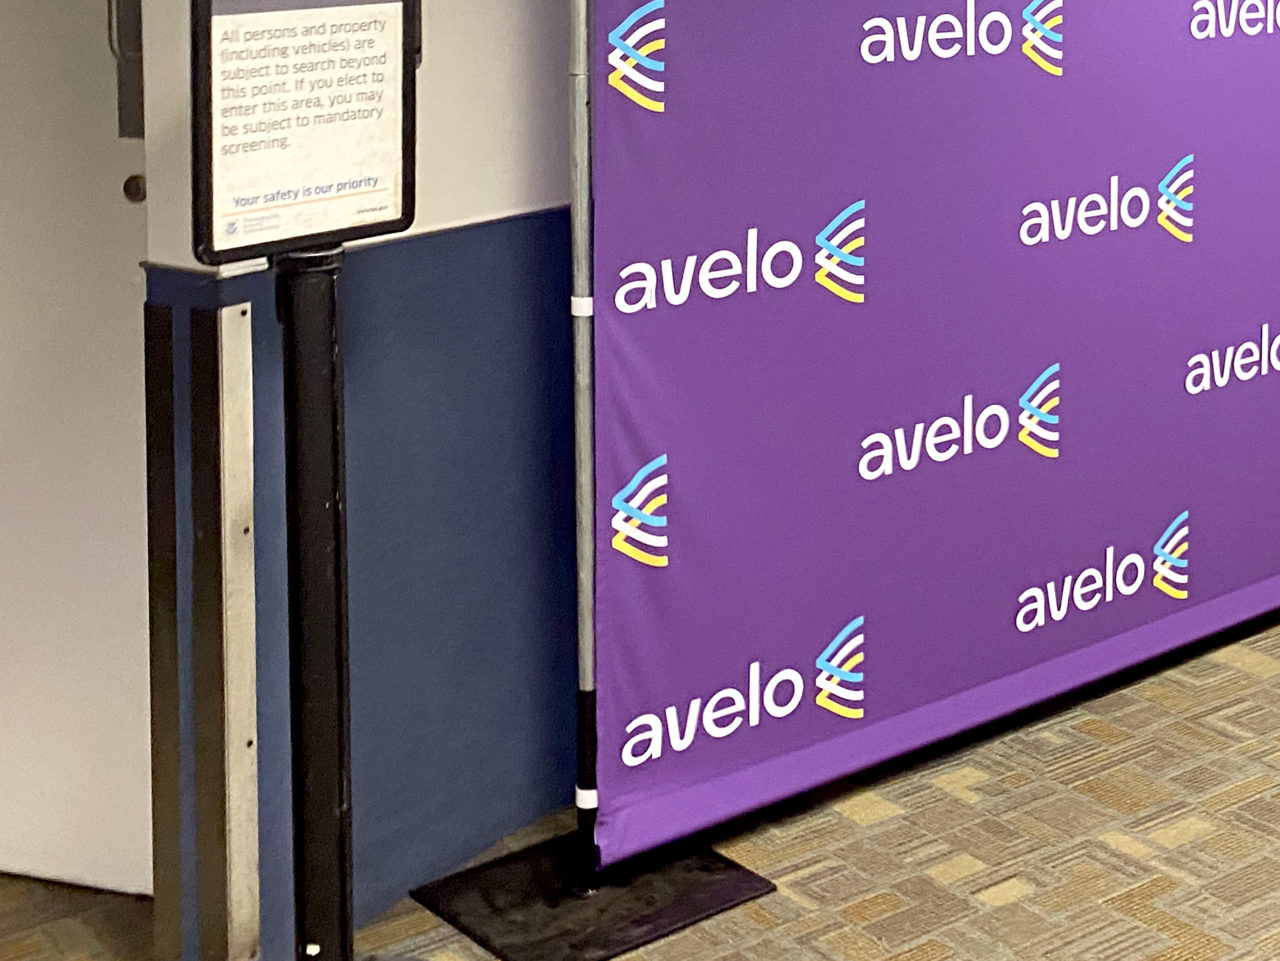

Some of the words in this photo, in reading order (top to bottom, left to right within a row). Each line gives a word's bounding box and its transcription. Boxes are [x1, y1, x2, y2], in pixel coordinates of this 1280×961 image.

[221, 29, 240, 42] All
[243, 25, 297, 42] persons
[301, 22, 326, 37] and
[330, 18, 386, 36] property
[220, 46, 289, 64] (including
[292, 39, 350, 55] vehicles)
[354, 37, 375, 49] are
[221, 65, 271, 82] subject
[275, 63, 289, 76] to
[293, 58, 335, 73] search
[339, 52, 387, 70] beyond
[221, 86, 247, 101] this
[251, 81, 290, 99] point.
[295, 78, 305, 92] If
[309, 78, 333, 93] you
[337, 73, 367, 87] elect
[371, 71, 384, 83] to
[221, 103, 258, 119] enter
[262, 100, 288, 115] this
[291, 96, 324, 110] area,
[328, 92, 352, 108] you
[356, 87, 384, 102] may
[221, 122, 239, 137] be
[242, 117, 293, 134] subject
[296, 114, 310, 127] to
[313, 106, 384, 127] mandatory
[220, 137, 291, 156] screening.
[233, 195, 261, 208] Your
[263, 187, 300, 204] safety
[303, 185, 313, 196] is
[314, 183, 335, 195] our
[336, 175, 379, 193] priority
[1019, 175, 1150, 246] avelo
[614, 227, 803, 314] avelo
[858, 394, 1010, 481] avelo
[1015, 545, 1145, 633] avelo
[621, 661, 804, 767] avelo
